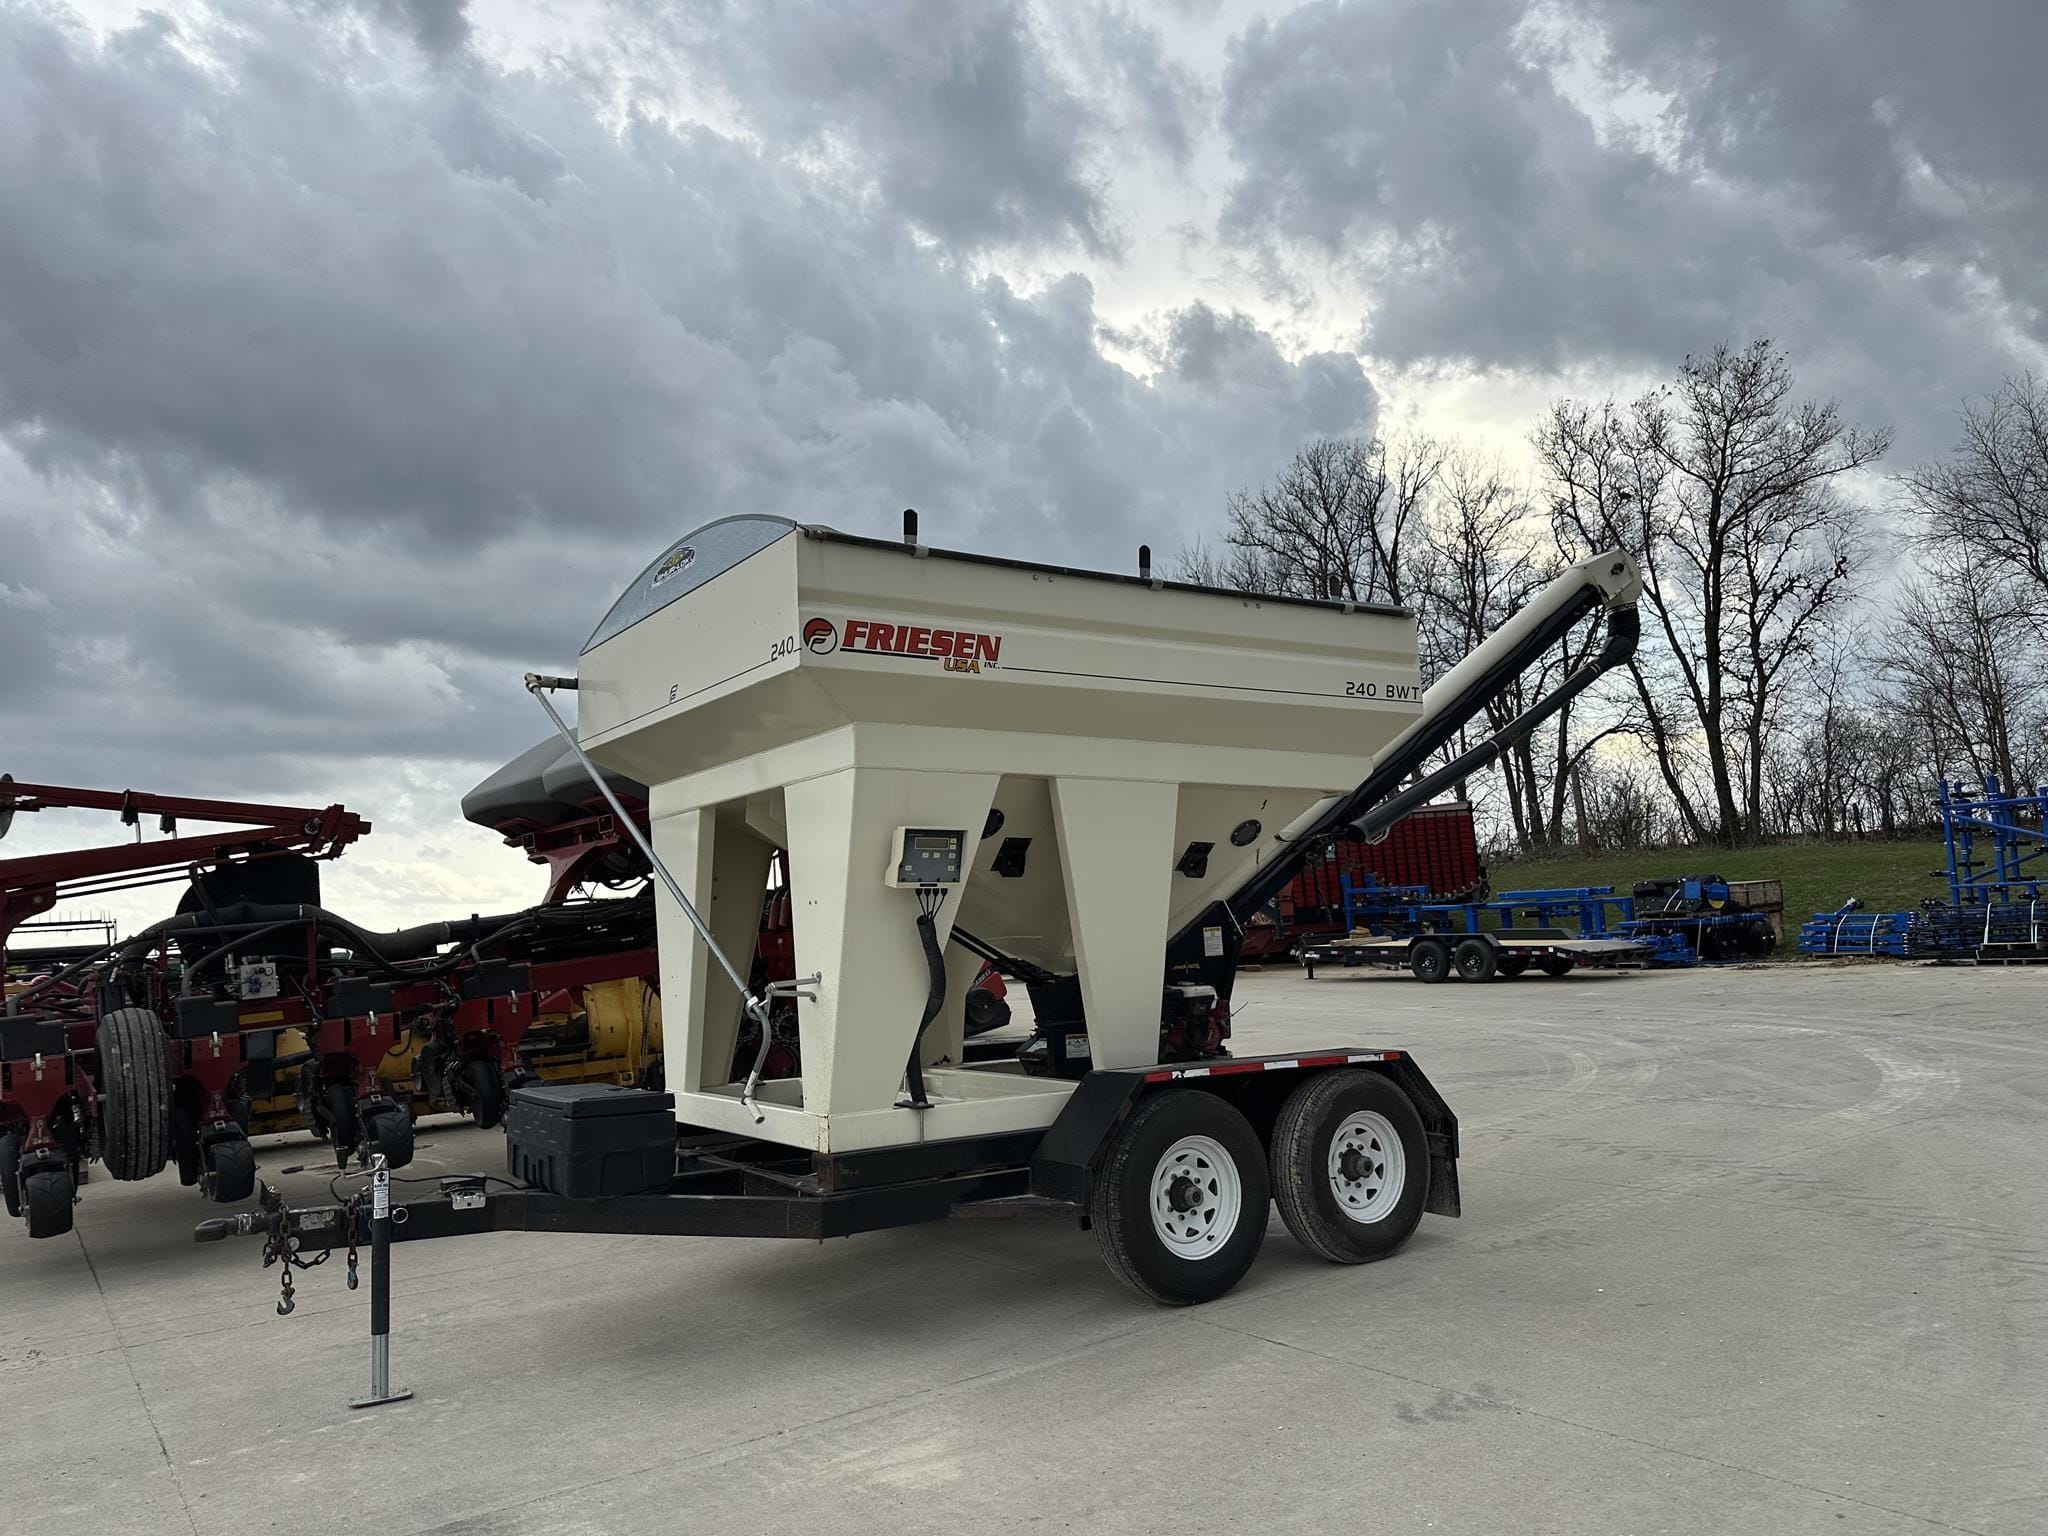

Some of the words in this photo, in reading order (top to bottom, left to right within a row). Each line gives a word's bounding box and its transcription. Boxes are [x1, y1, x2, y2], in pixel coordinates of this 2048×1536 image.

[771, 635, 794, 662] 240
[842, 619, 1002, 662] FRIESEN
[943, 657, 981, 674] USA
[1345, 681, 1377, 697] 240
[1386, 684, 1420, 700] BWT
